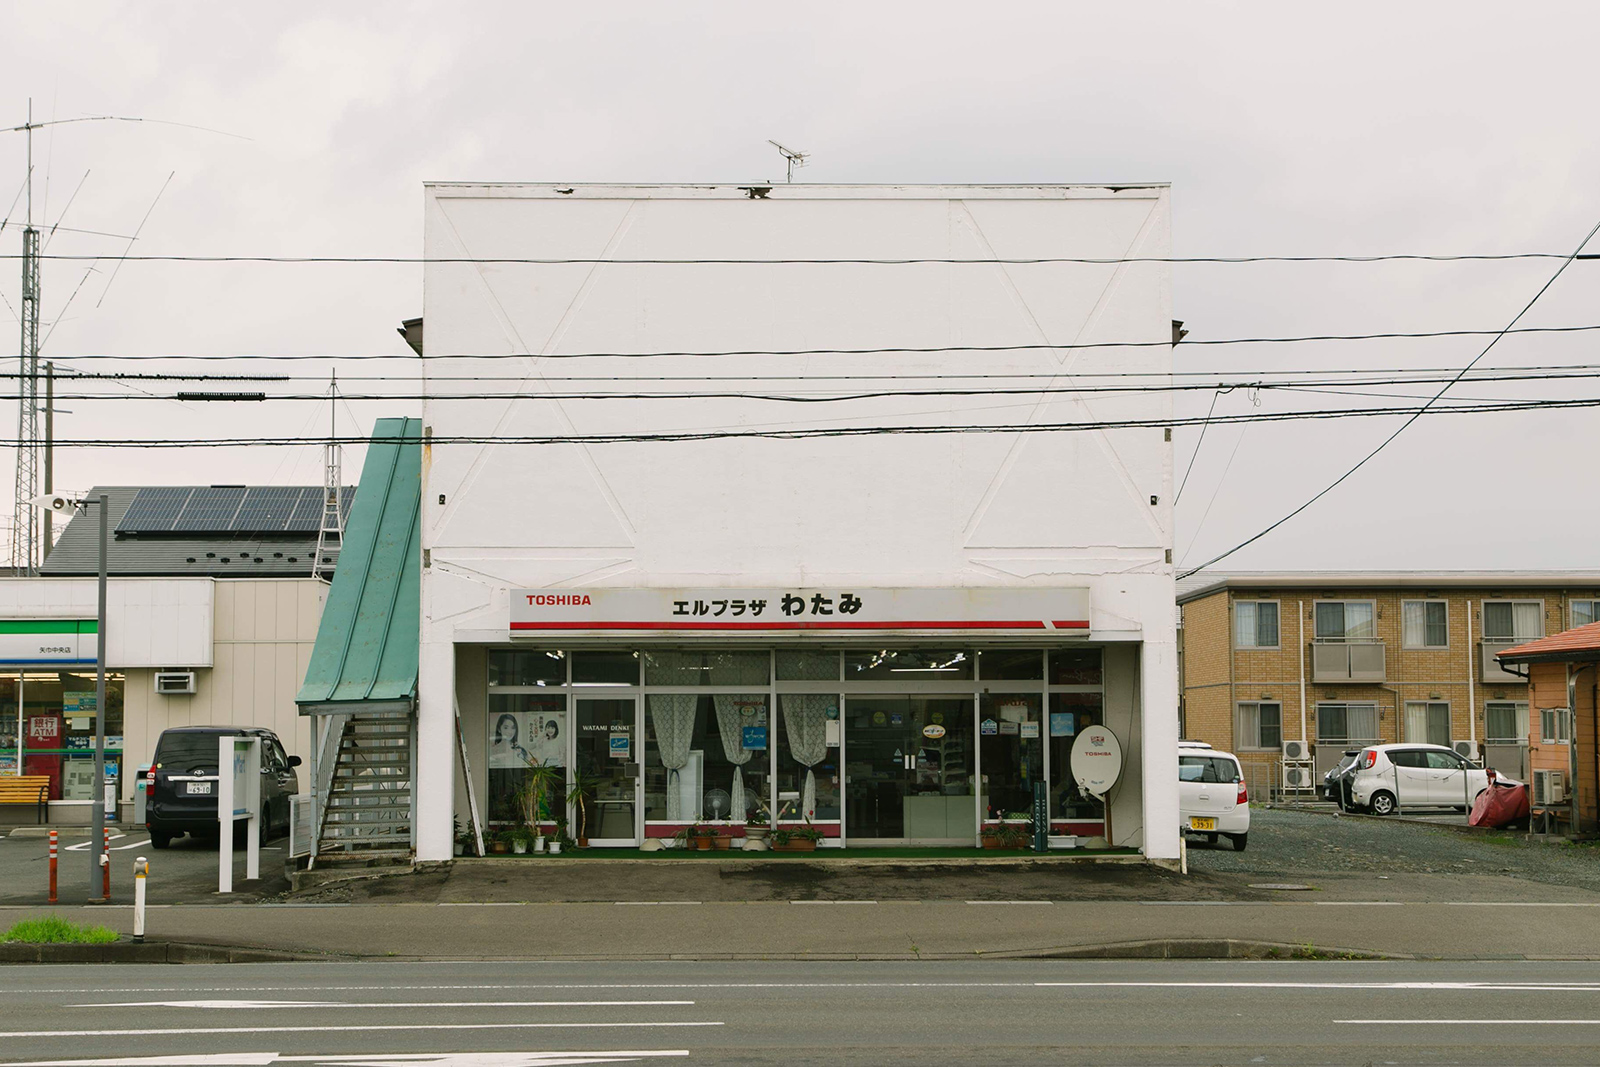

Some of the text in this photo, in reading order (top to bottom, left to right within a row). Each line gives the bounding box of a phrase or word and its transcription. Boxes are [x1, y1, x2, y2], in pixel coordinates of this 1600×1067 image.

[526, 595, 592, 606] TOSHIBA
[673, 592, 862, 617] エルプラザ わたみ
[39, 646, 71, 654] 矢巾中央店
[34, 718, 55, 728] 銀行
[33, 728, 54, 736] ATM
